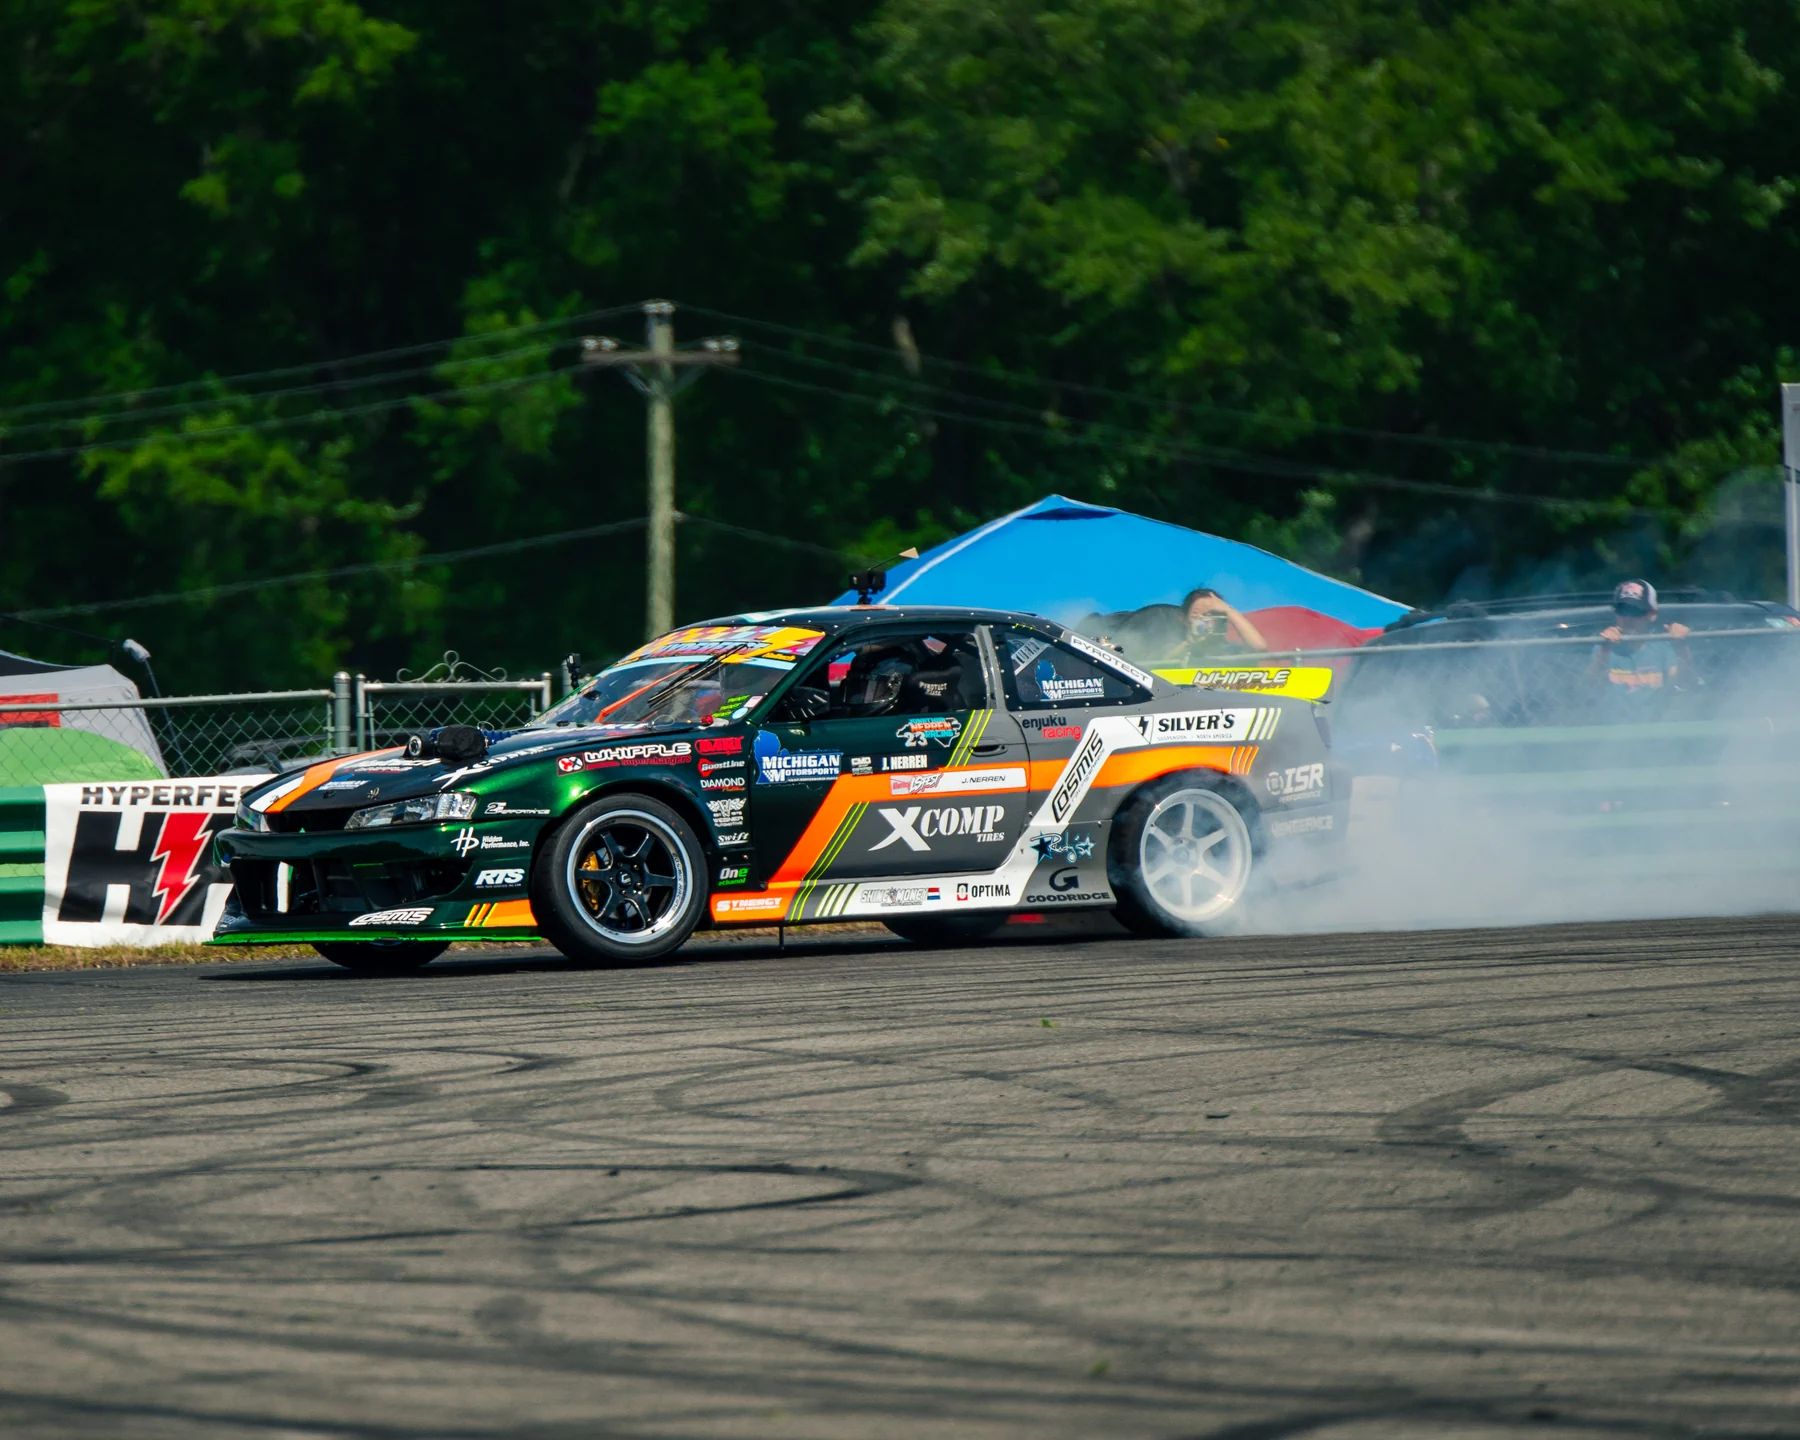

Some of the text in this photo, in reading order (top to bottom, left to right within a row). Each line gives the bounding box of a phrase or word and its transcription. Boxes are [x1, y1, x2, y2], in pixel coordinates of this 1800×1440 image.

[1072, 638, 1149, 682] PYROTECT
[1042, 678, 1102, 689] MICHIGAN
[1193, 670, 1291, 684] WHIPPLE
[1049, 688, 1103, 699] MOTORSPORTS
[1022, 715, 1066, 731] enjuku
[1158, 711, 1236, 733] SILVER'S
[904, 731, 928, 748] 23
[1042, 726, 1081, 740] racing
[584, 742, 692, 763] WHIPPLE
[762, 754, 840, 769] MICHIGAN
[890, 755, 928, 770] NERREN
[769, 767, 840, 782] MOTORSPORTS
[969, 775, 1006, 783] NERREN
[1283, 763, 1324, 794] ISR
[700, 777, 745, 788] DIAMOND
[717, 832, 749, 843] Swift
[977, 832, 1005, 843] TIRES
[475, 868, 525, 886] RTS
[719, 867, 750, 880] One
[971, 884, 1011, 898] OPTIMA
[1026, 892, 1111, 903] GOODRIDGE
[716, 897, 783, 912] SYNERGY
